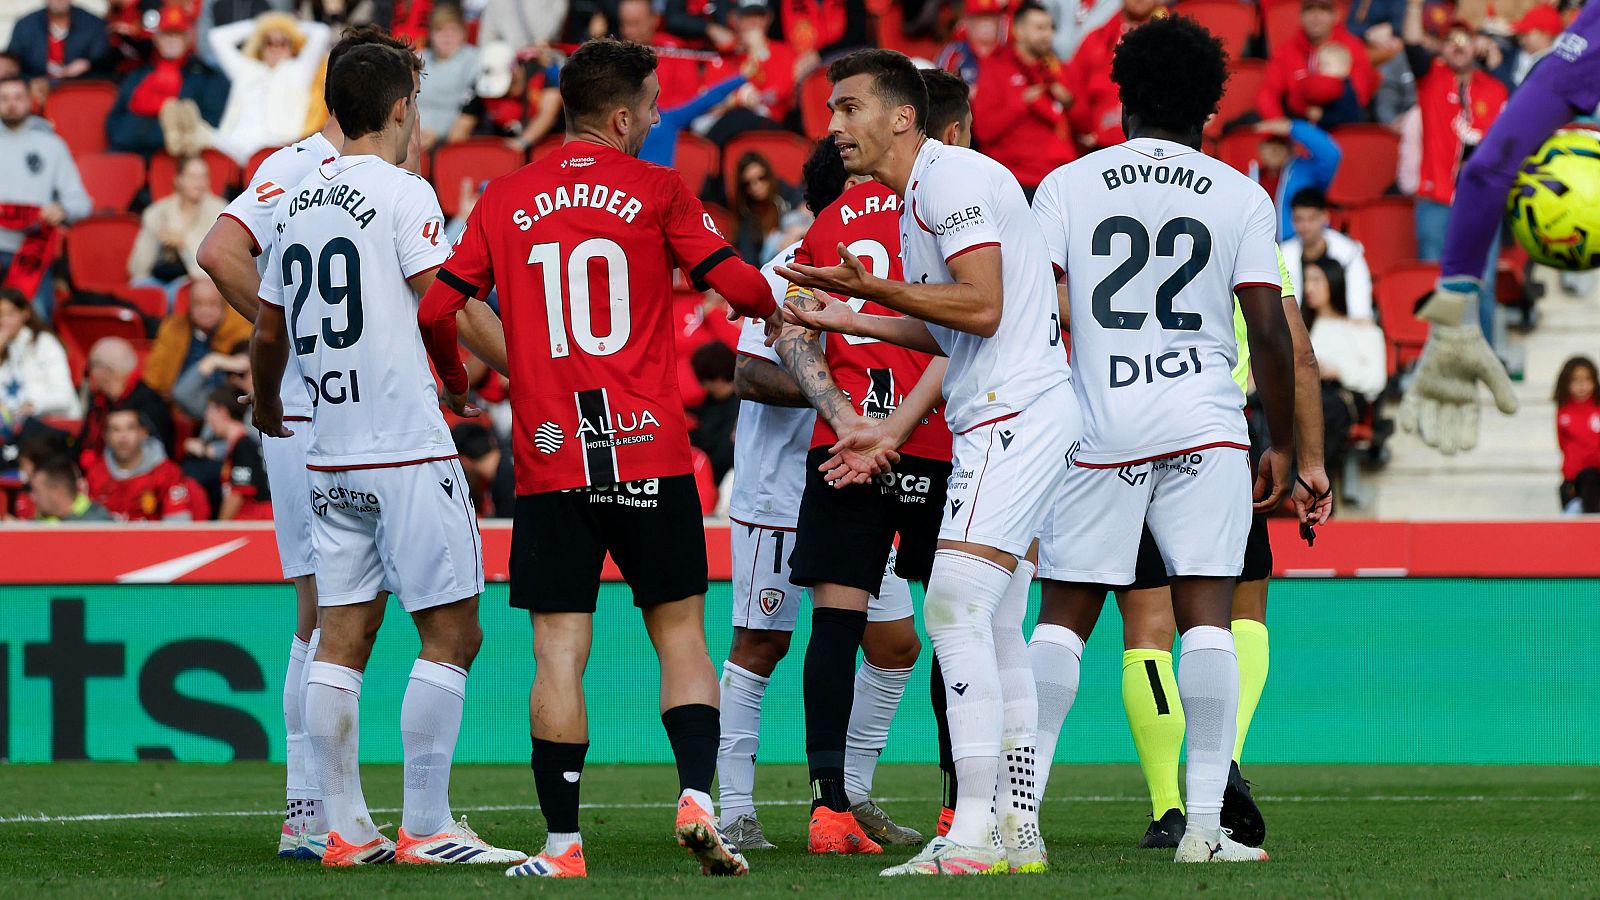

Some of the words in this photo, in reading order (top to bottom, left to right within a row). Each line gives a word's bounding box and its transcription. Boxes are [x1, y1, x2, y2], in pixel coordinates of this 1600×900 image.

[1102, 164, 1212, 195] BOYOMO
[512, 183, 643, 231] S.DARDER
[840, 194, 904, 226] A.RA
[1092, 216, 1212, 331] 22
[282, 237, 364, 356] 29
[527, 238, 631, 358] 10
[1110, 348, 1202, 389] DIGI
[575, 410, 660, 438] ALUA
[586, 440, 615, 449] HOTELS
[622, 434, 654, 445] RESORTS
[589, 494, 613, 503] Illes
[617, 495, 658, 508] Balears
[899, 494, 927, 504] alears
[0, 597, 270, 761] ts
